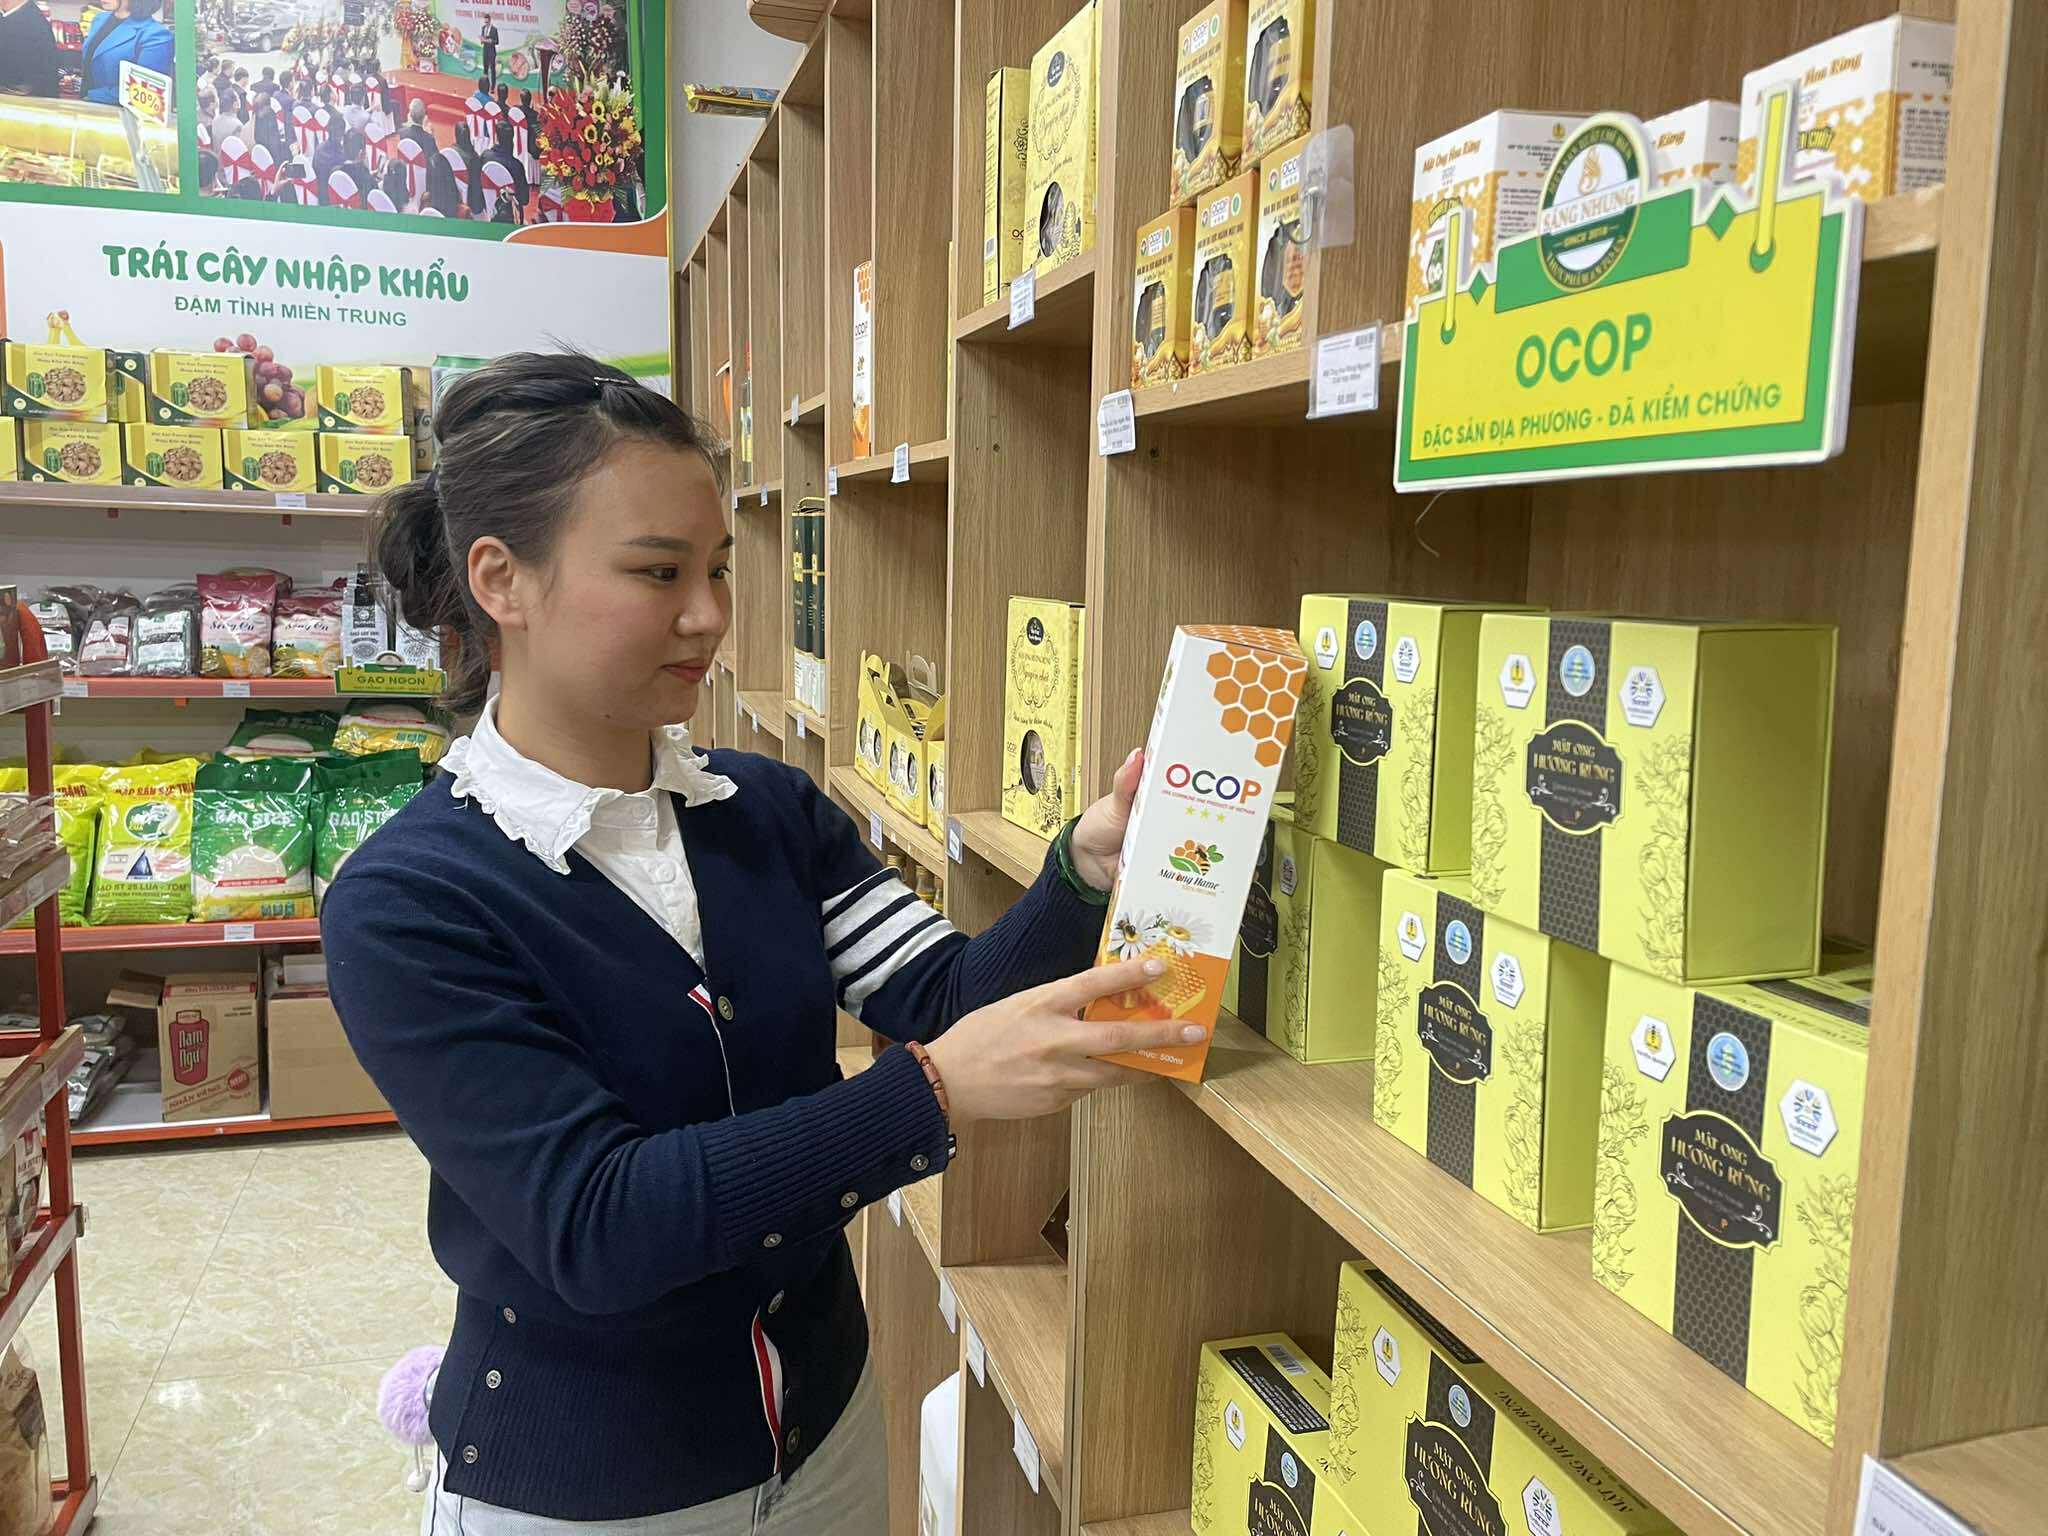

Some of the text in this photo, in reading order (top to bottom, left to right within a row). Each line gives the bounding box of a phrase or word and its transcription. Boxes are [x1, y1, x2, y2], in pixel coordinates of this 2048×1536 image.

[132, 88, 160, 112] 20%
[101, 239, 469, 302] TRÁI CÂY NHẬP KHẨU
[227, 296, 274, 317] TÌNH
[337, 307, 407, 326] TRUNG
[1515, 312, 1653, 389] OCOP
[1423, 422, 1454, 453] ĐẶC
[1456, 416, 1486, 444] SẢN
[1489, 419, 1515, 446] ĐỊA
[1520, 407, 1593, 438] PHƯƠNG
[1607, 395, 1636, 427] ĐÃ
[1641, 383, 1690, 423] KIỂM
[1695, 379, 1782, 417] CHỨNG
[1165, 763, 1263, 804] OCOP
[1533, 751, 1615, 784] HƯƠNG RỪNG
[178, 1029, 204, 1050] Nam
[1423, 1003, 1487, 1047] HƯƠNG RỪNG
[1671, 1136, 1772, 1203] HƯƠNG RỪNG
[1694, 1128, 1748, 1167] MẬT ONG
[1413, 1441, 1458, 1500] HƯƠNG
[1433, 1441, 1478, 1496] MẬT ONG
